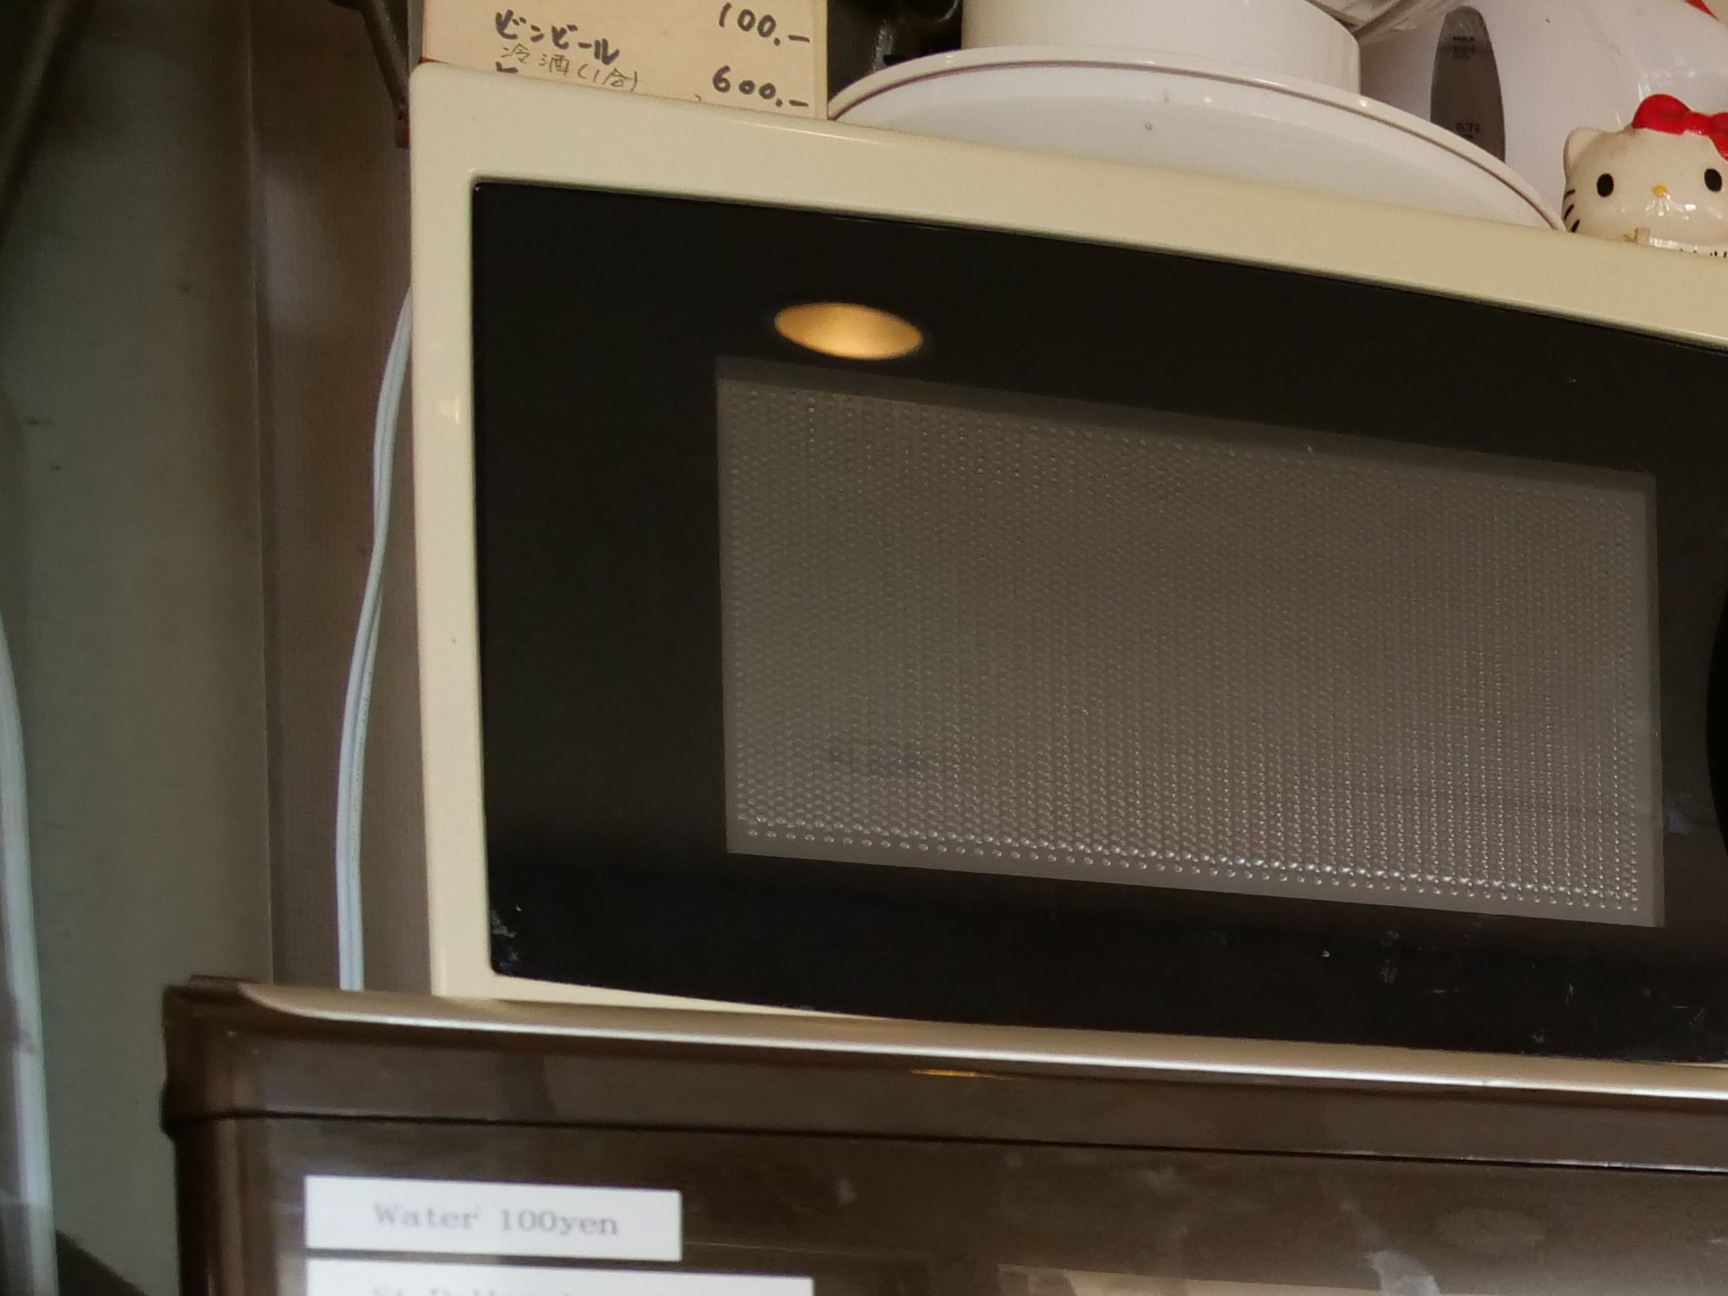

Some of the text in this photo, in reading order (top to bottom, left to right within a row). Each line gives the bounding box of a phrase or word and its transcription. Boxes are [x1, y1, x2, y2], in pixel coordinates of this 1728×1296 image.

[495, 9, 619, 65] ビンビール
[373, 1203, 619, 1238] Water 100yen
